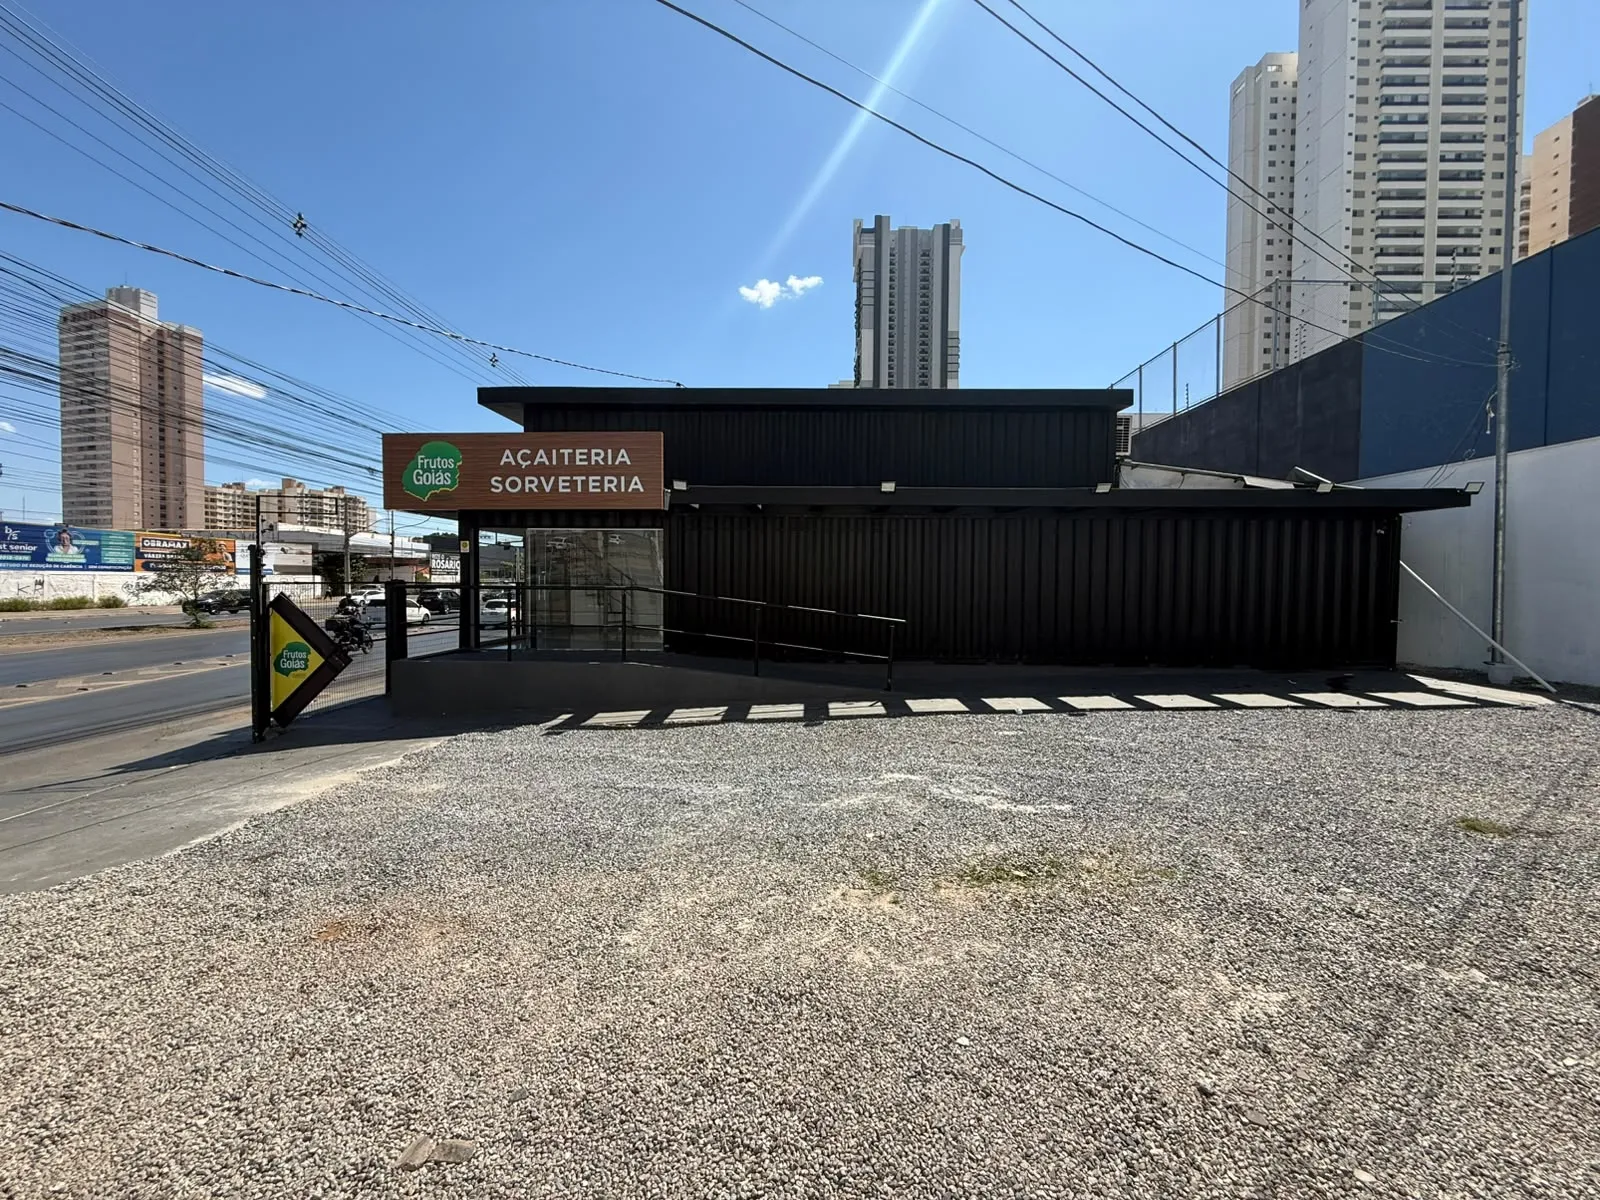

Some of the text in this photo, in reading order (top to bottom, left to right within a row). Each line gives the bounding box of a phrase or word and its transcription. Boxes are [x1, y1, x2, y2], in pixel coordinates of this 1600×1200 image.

[417, 455, 455, 469] Frutos
[500, 448, 632, 469] AÇAITERIA
[412, 468, 452, 485] Goiás
[490, 475, 645, 493] SORVETERIA
[9, 543, 38, 551] senior
[143, 539, 188, 549] OBRAMAX
[283, 650, 307, 659] Frutos
[280, 659, 305, 668] Goiás
